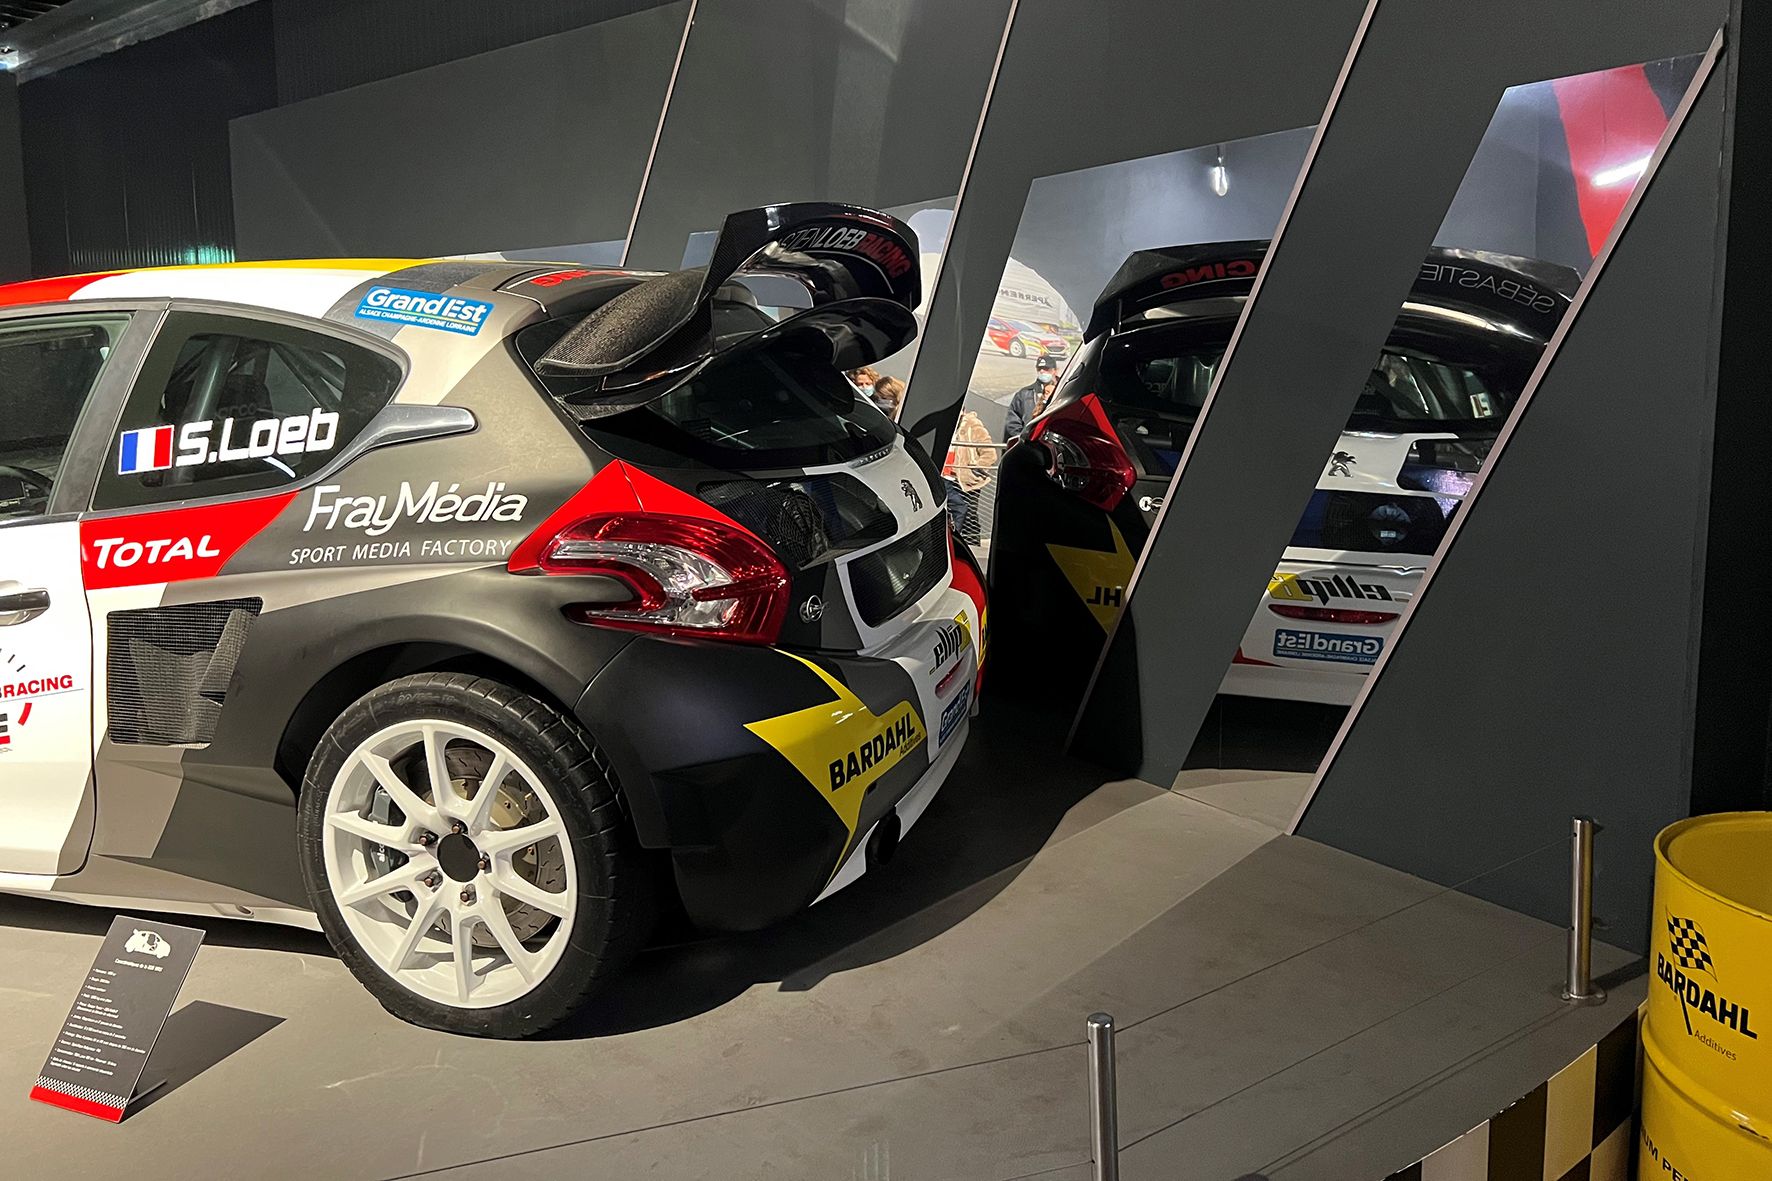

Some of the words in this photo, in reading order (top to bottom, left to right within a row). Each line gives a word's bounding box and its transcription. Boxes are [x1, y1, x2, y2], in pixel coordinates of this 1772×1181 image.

[176, 408, 339, 466] S.Loeb
[93, 535, 220, 569] TOTAL
[289, 545, 347, 564] SPORT
[352, 542, 411, 560] MEDIA
[421, 539, 511, 557] FACTORY
[0, 674, 73, 699] RACING
[829, 712, 916, 792] BARDAHL
[1657, 952, 1758, 1040] BARDAHL
[1694, 1029, 1737, 1061] Additives
